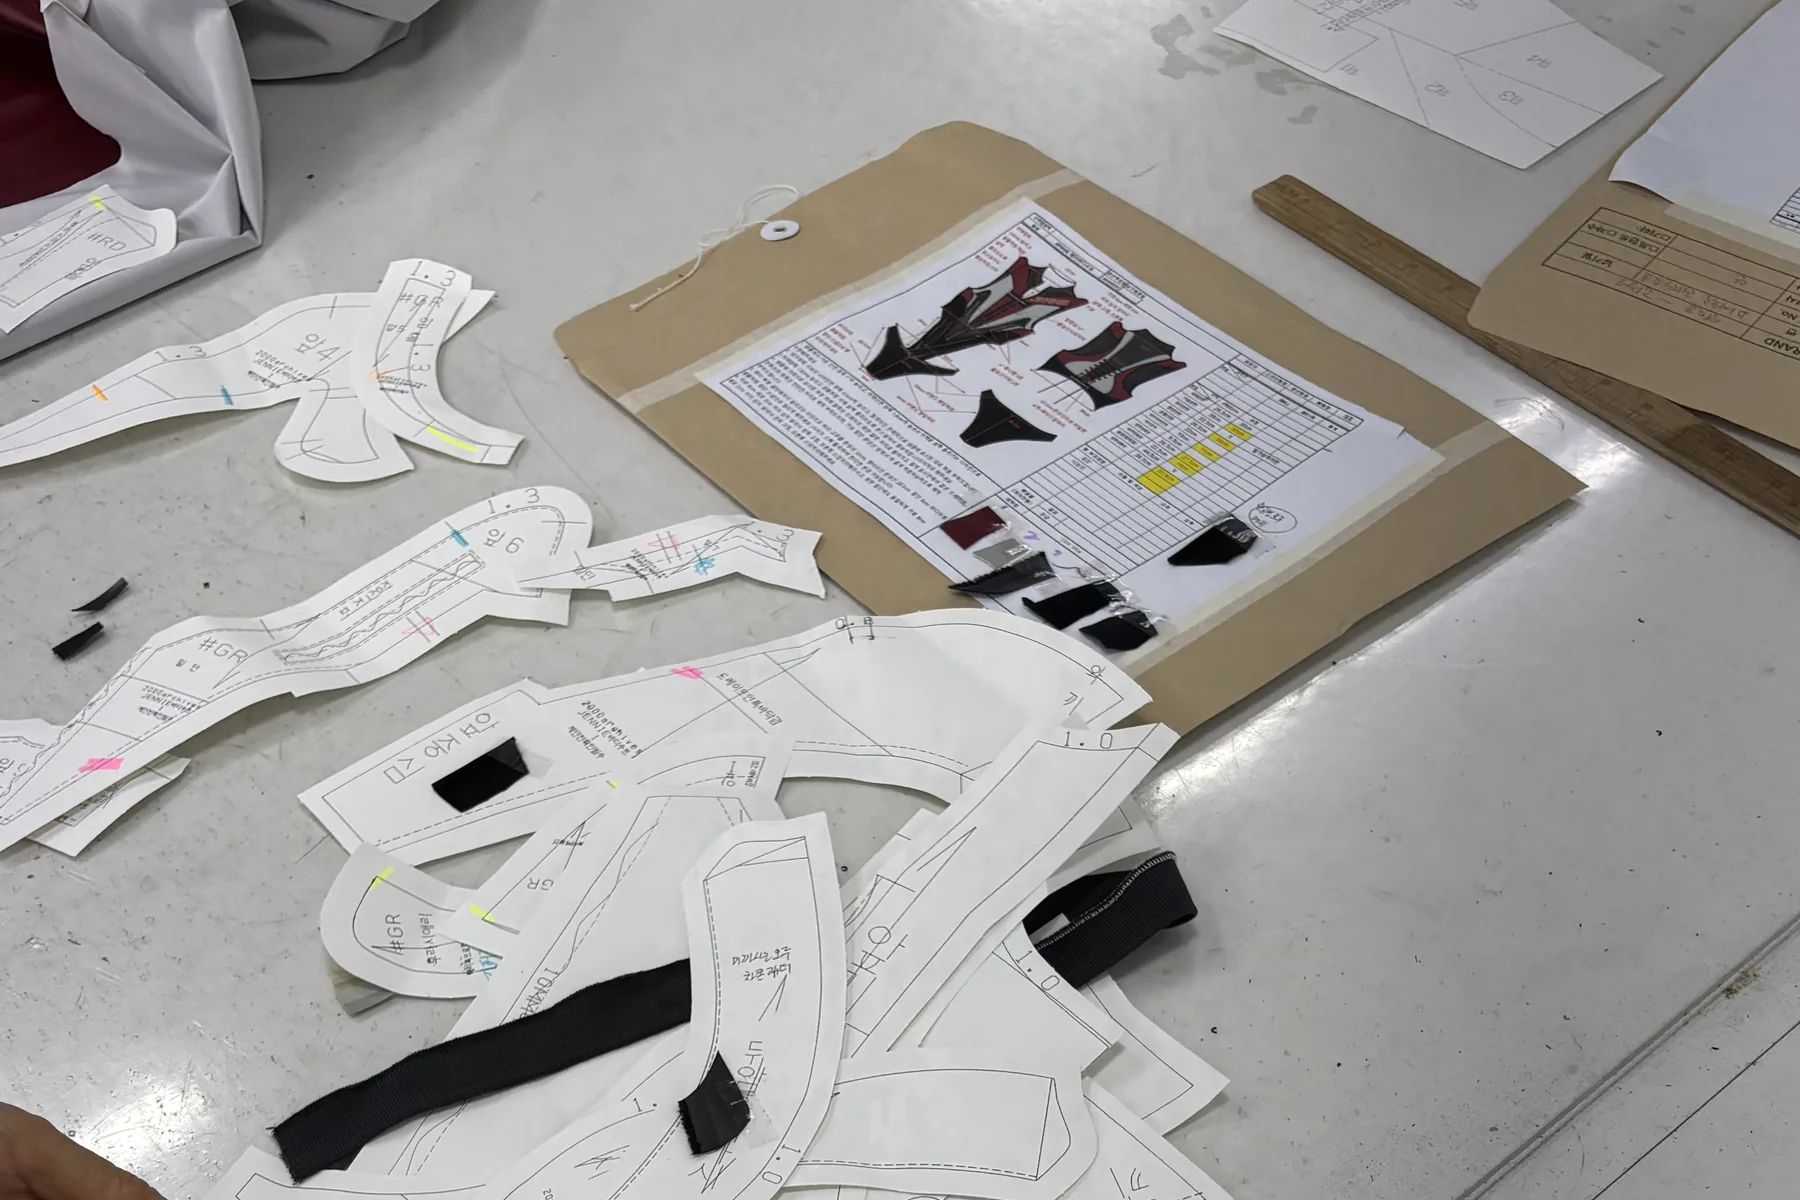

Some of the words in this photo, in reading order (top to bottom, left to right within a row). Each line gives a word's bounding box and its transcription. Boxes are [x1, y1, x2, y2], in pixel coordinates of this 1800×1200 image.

[198, 636, 249, 664] #GR
[1064, 731, 1114, 751] 1.0
[1015, 949, 1061, 992] 1.0
